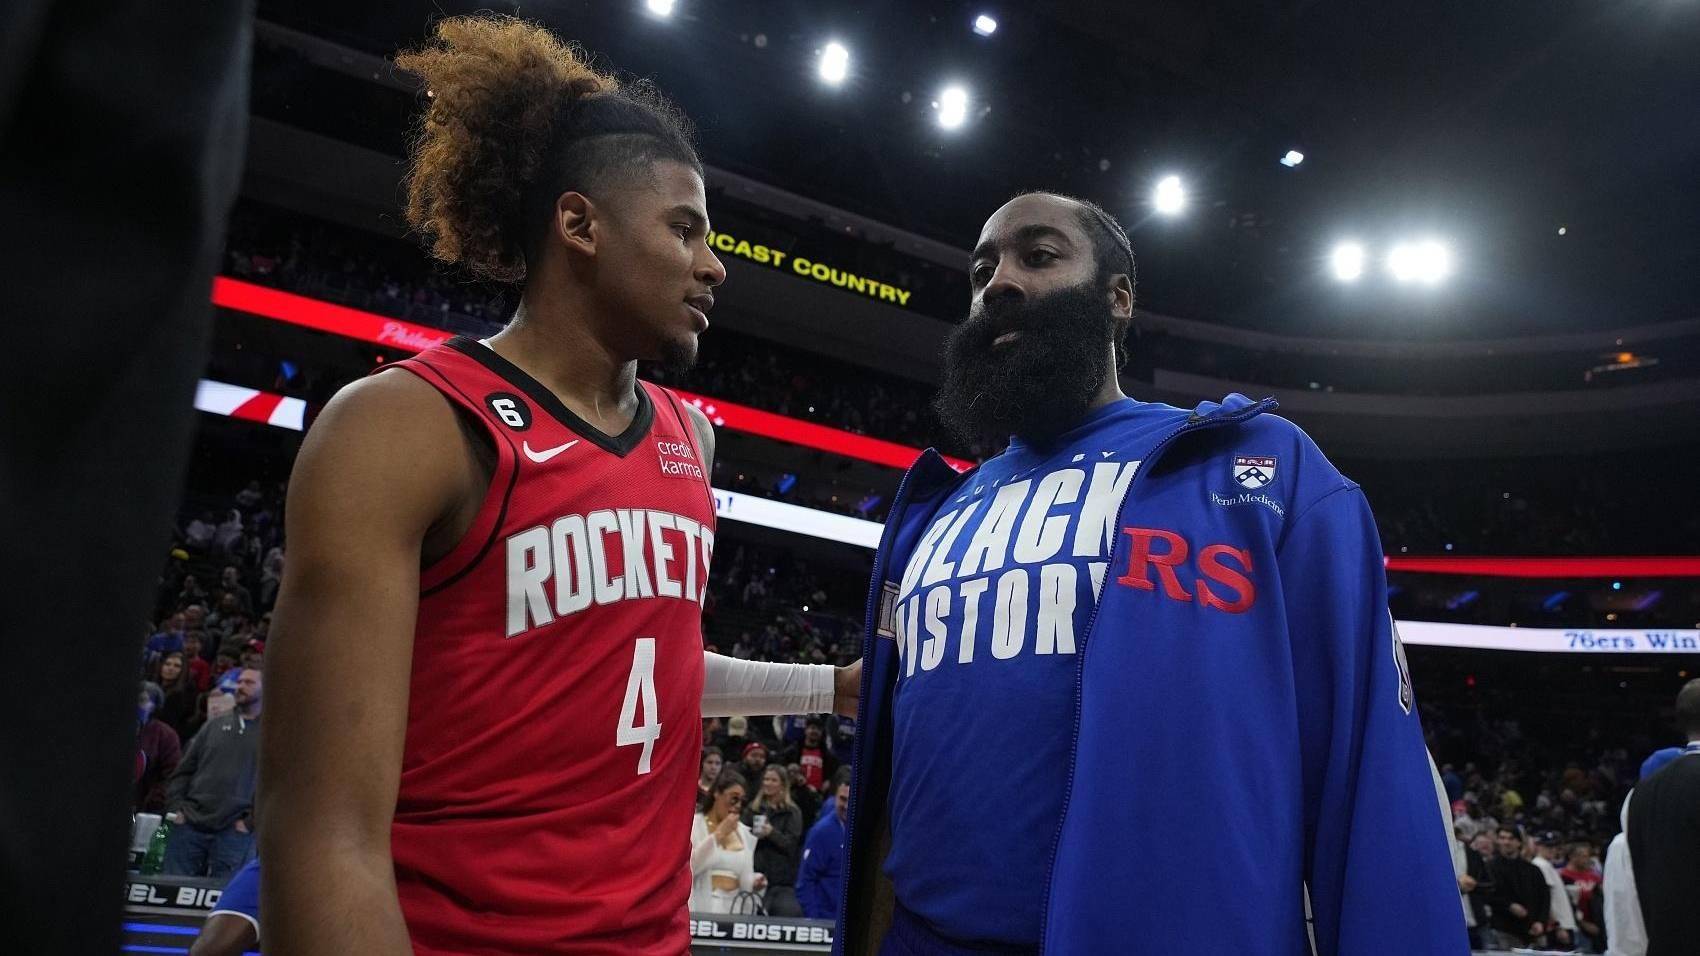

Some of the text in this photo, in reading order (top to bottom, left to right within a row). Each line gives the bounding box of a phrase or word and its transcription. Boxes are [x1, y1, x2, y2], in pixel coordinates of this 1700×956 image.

[792, 258, 910, 305] COUNTRY
[492, 399, 525, 428] 6
[657, 441, 695, 460] credit
[659, 456, 703, 479] karma
[1212, 492, 1285, 516] Penn Medicine
[897, 460, 1141, 606] BLACK
[506, 508, 714, 639] ROCKETS
[1116, 527, 1257, 614] RS
[1564, 632, 1635, 649] 76ers
[616, 637, 662, 775] 4
[125, 883, 168, 904] EL
[733, 923, 834, 943] BIOSTEEL
